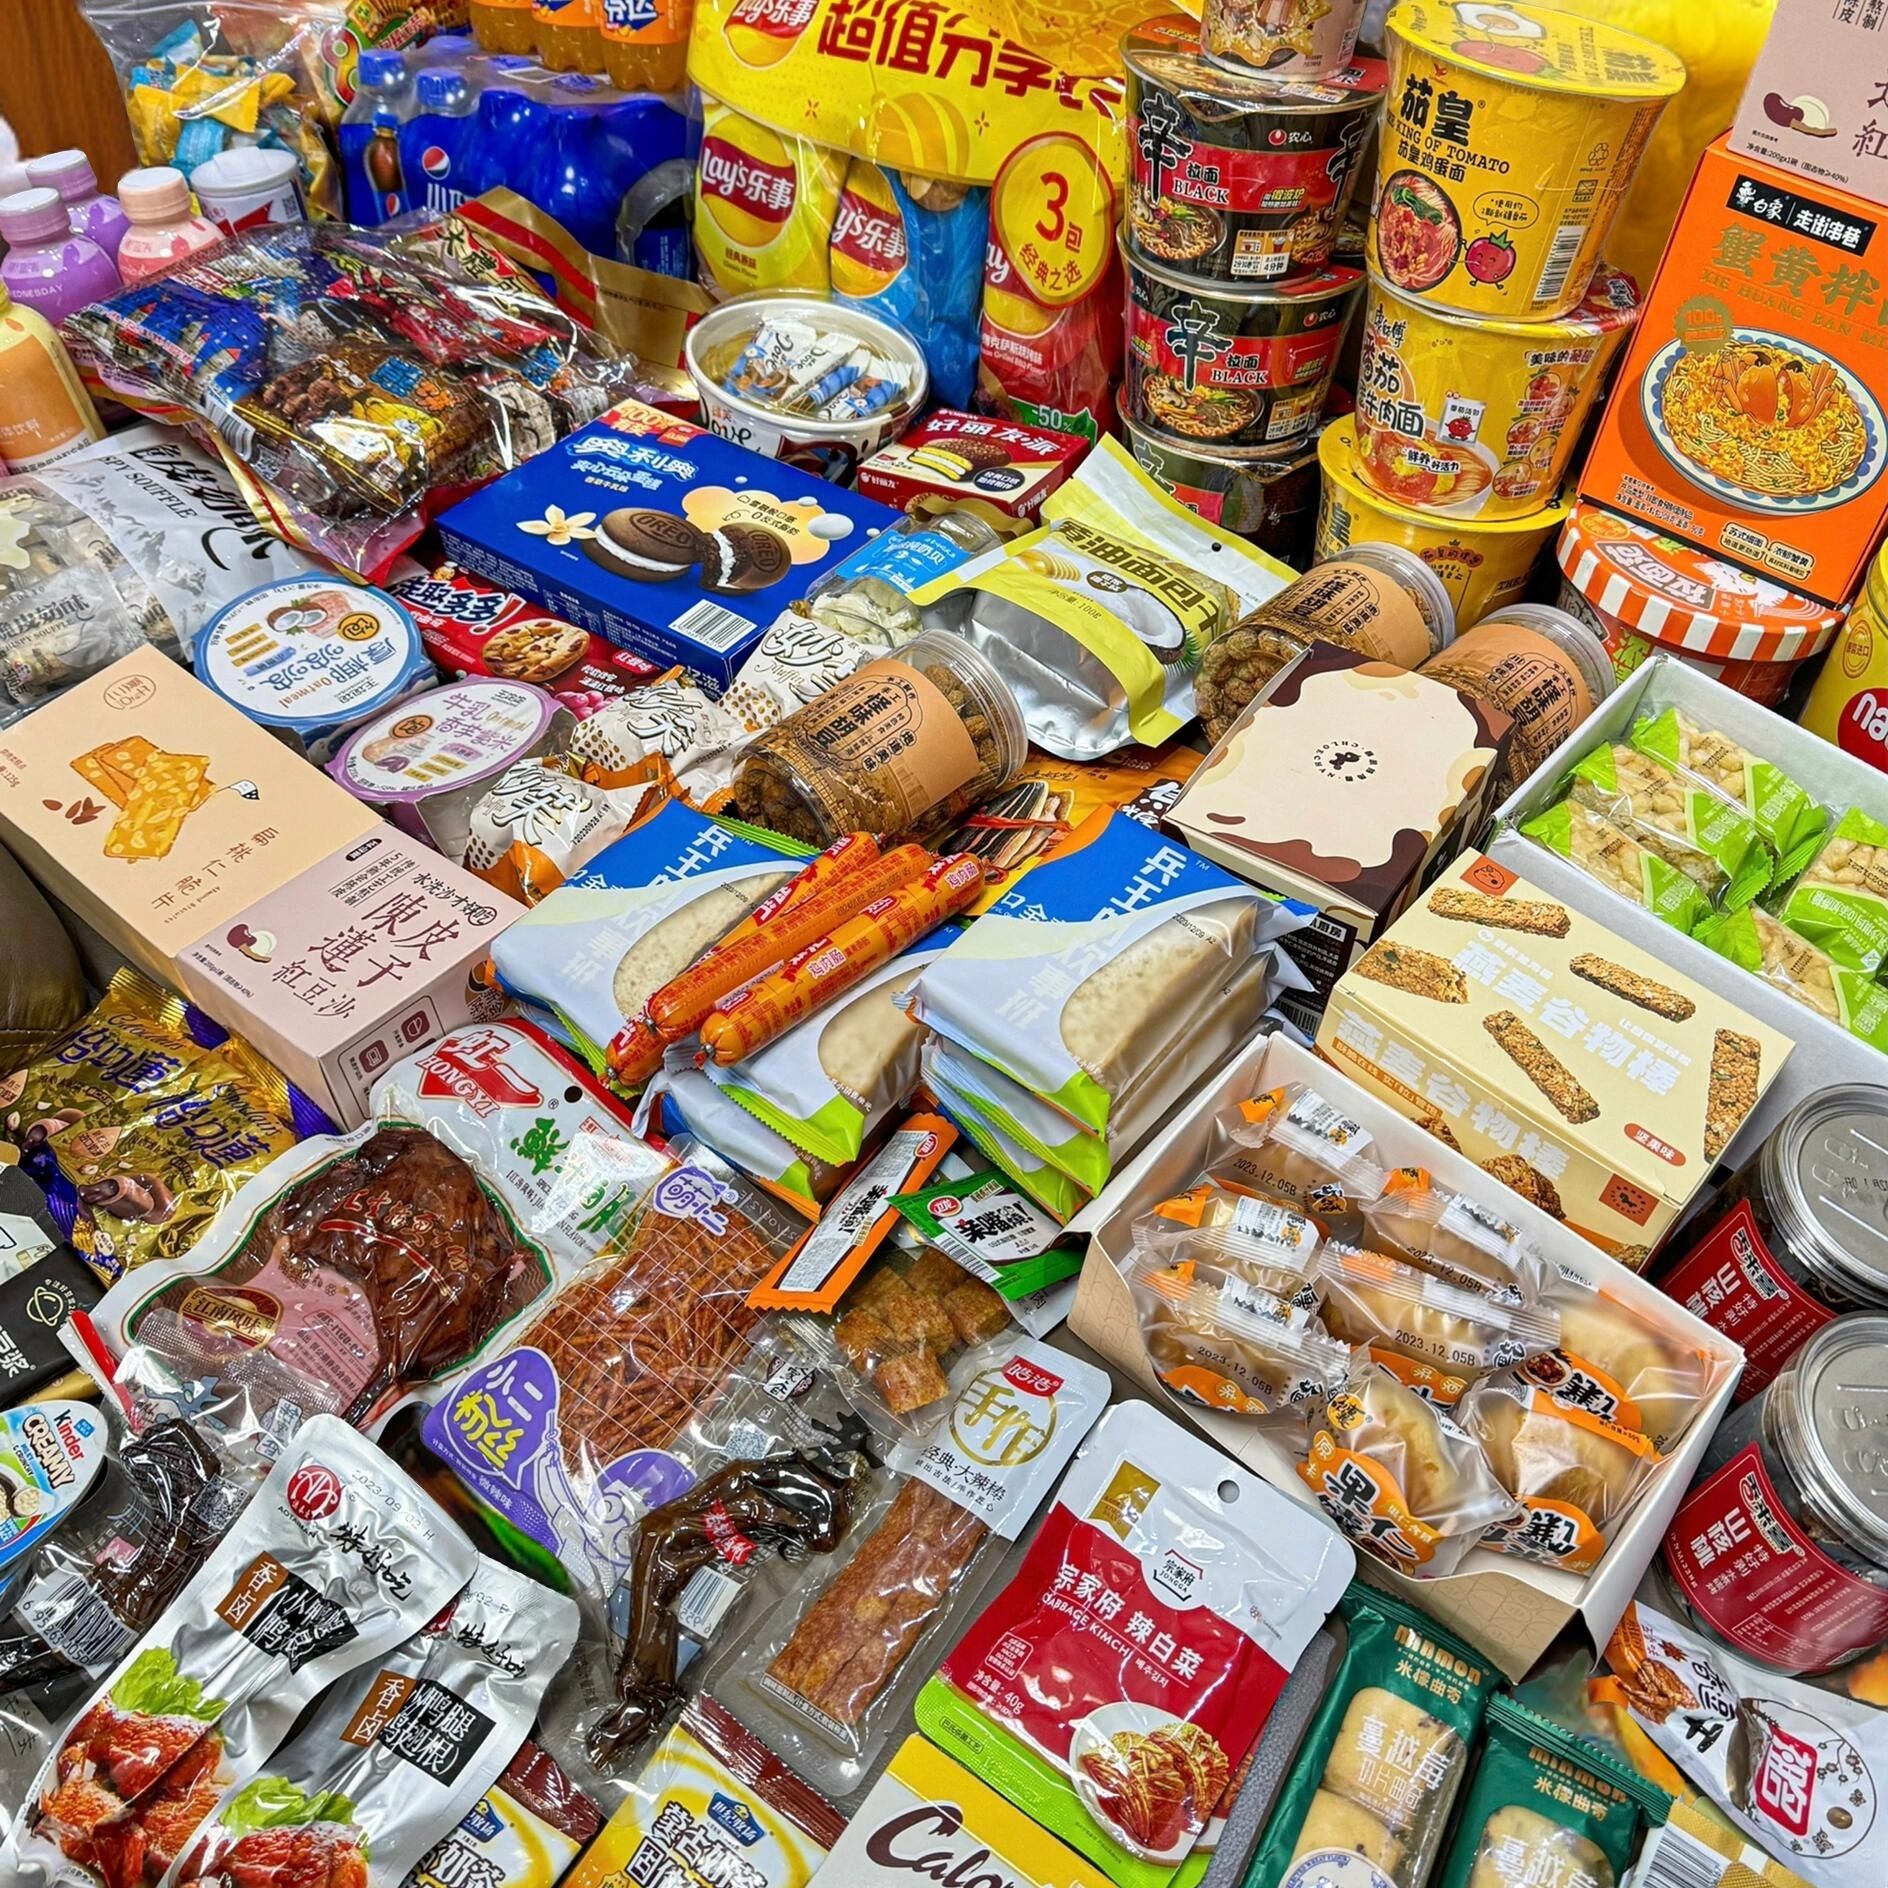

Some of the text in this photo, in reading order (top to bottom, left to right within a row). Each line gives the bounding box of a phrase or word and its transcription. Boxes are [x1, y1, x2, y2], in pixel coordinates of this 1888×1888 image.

[1400, 73, 1475, 147] 茄皇
[1138, 92, 1193, 207] 辛
[1186, 162, 1220, 185] 拉面
[1395, 120, 1422, 145] KING
[1424, 136, 1443, 151] OF
[1446, 145, 1511, 175] TOMATO
[1397, 140, 1467, 184] 茄皇鸡蛋面
[702, 148, 795, 211] Lay's 乐事
[1035, 172, 1069, 242] 3
[1172, 178, 1230, 205] BLACK
[1792, 209, 1865, 250] 走街串巷
[9, 283, 64, 300] EDNESDAY
[1018, 243, 1083, 292] 经典之选
[1711, 221, 1888, 328] 蟹黄拌
[1164, 300, 1234, 395] 辛
[1225, 353, 1261, 371] 拉面
[1210, 368, 1269, 386] BLACK
[127, 469, 198, 520] SOUFFLE
[278, 674, 334, 709] Oatmeal
[808, 691, 889, 751] 怪味胡豆
[861, 727, 918, 774] 地道美味
[411, 870, 499, 928] 水洗沙才好吃
[944, 862, 980, 890] 鸡肉肠
[360, 890, 461, 963] 陳皮
[306, 923, 413, 990] 蓮子
[806, 948, 847, 980] 鸡肉肠
[271, 959, 358, 1020] 紅豆沙
[1452, 939, 1682, 1097] 燕麦谷物棒
[417, 1053, 500, 1119] HONGYI
[1635, 1127, 1676, 1162] 坚果味
[1232, 1156, 1297, 1197] 2023.12.05B
[1406, 1246, 1483, 1292] 2023.12.05B
[1197, 1345, 1274, 1396] 2023.12.05B
[1394, 1329, 1476, 1367] 2023.12.05B
[22, 1413, 76, 1489] CREAMY
[54, 1408, 85, 1461] Kinder
[453, 1389, 525, 1470] 粉丝
[351, 1469, 436, 1541] 2023/09/02 H
[1690, 1507, 1753, 1569] 山核桃
[1159, 1570, 1189, 1594] JONGGA
[1163, 1557, 1197, 1588] 宗家府
[1042, 1590, 1089, 1626] CABBAGE
[1134, 1658, 1169, 1690] 배추김치
[1051, 1563, 1205, 1681] 宗家府 辣白菜
[1004, 1690, 1026, 1716] 40g
[1355, 1712, 1452, 1792] 蔓越莓
[1528, 1745, 1630, 1804] minmon
[865, 1803, 1018, 1888] Calo
